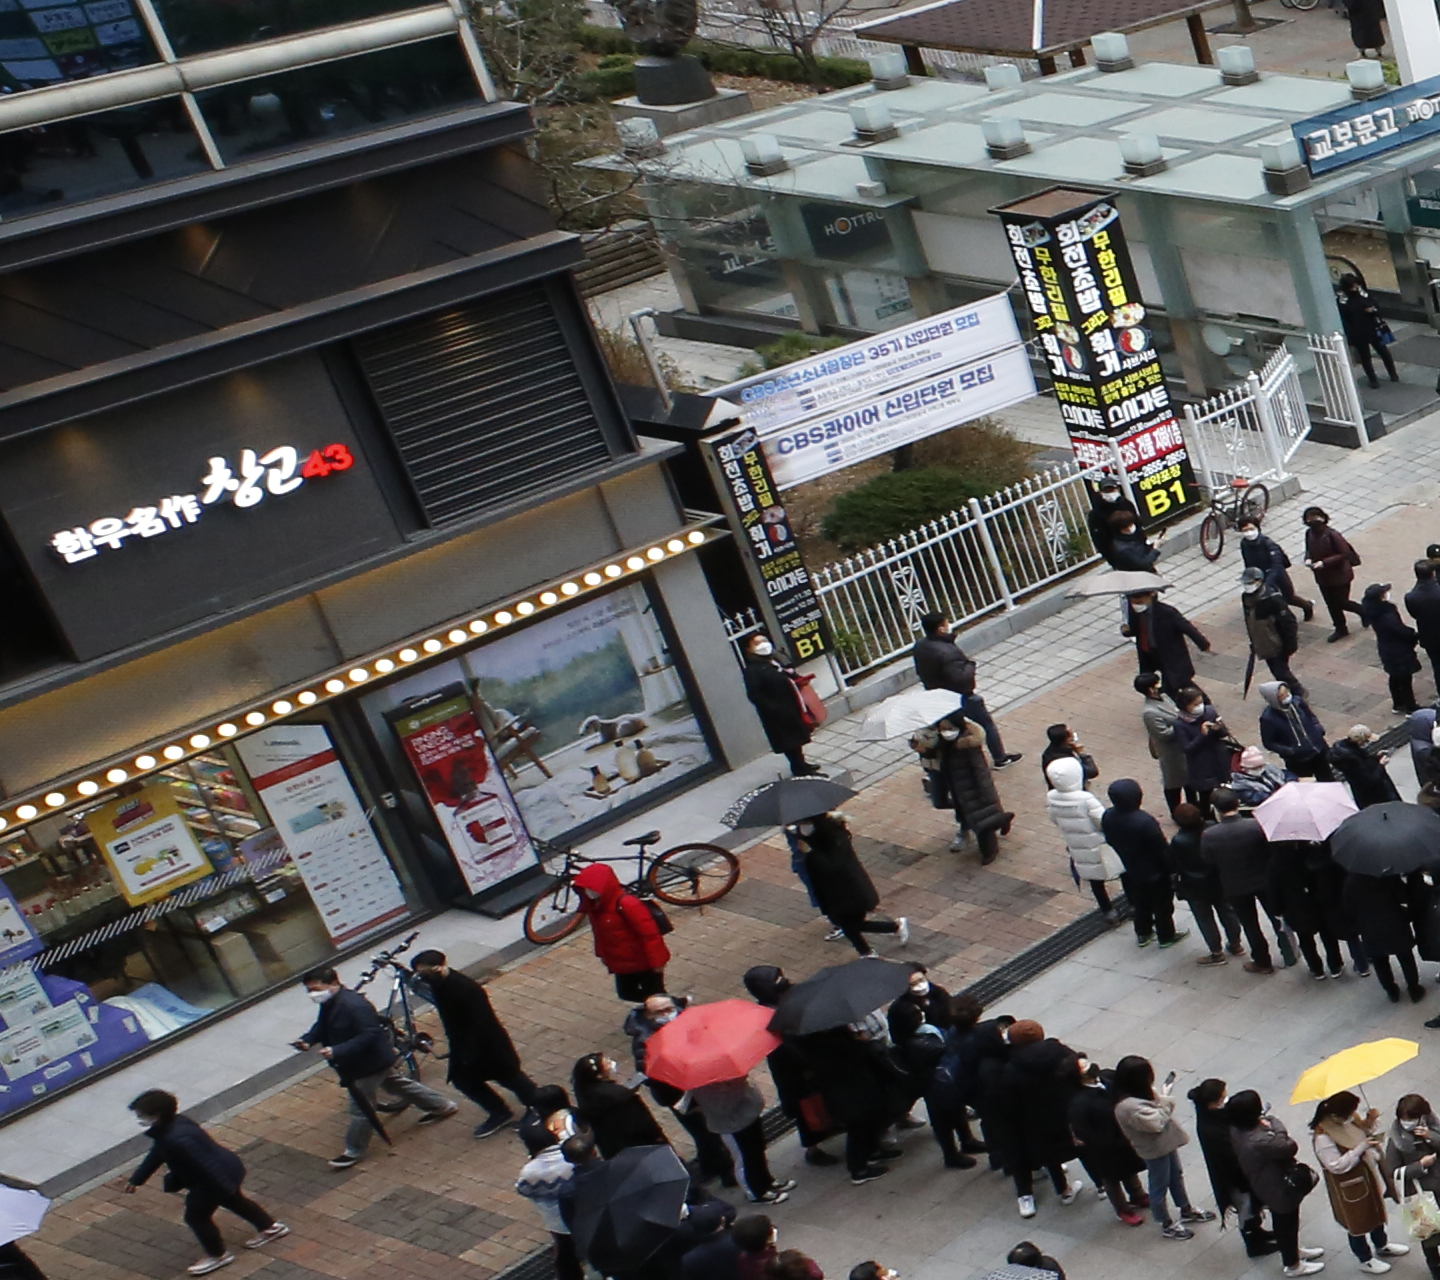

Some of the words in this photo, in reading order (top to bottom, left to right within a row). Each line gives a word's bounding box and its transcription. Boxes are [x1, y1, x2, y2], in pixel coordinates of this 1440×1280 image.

[1308, 107, 1399, 161] 교보문고
[1005, 223, 1048, 314] 회전초밥
[1055, 220, 1104, 314] 회전초밥
[1091, 230, 1129, 307] 무한리필
[740, 351, 866, 403] CBS소년소녀합창단
[868, 339, 902, 360] 35기
[904, 321, 954, 348] 신입단원
[955, 311, 981, 332] 모집
[1089, 328, 1121, 377] 훠거
[1122, 348, 1158, 370] 샤브샤브
[777, 404, 881, 456] CBS콰이어
[884, 377, 955, 421] 신입단원
[959, 363, 995, 392] 모집
[1108, 385, 1169, 428] 스시가든
[1139, 464, 1182, 491] 예약포장
[1145, 480, 1187, 517] B1
[51, 494, 203, 564] 한우名作
[767, 568, 809, 597] 스시가든
[796, 632, 825, 659] B1
